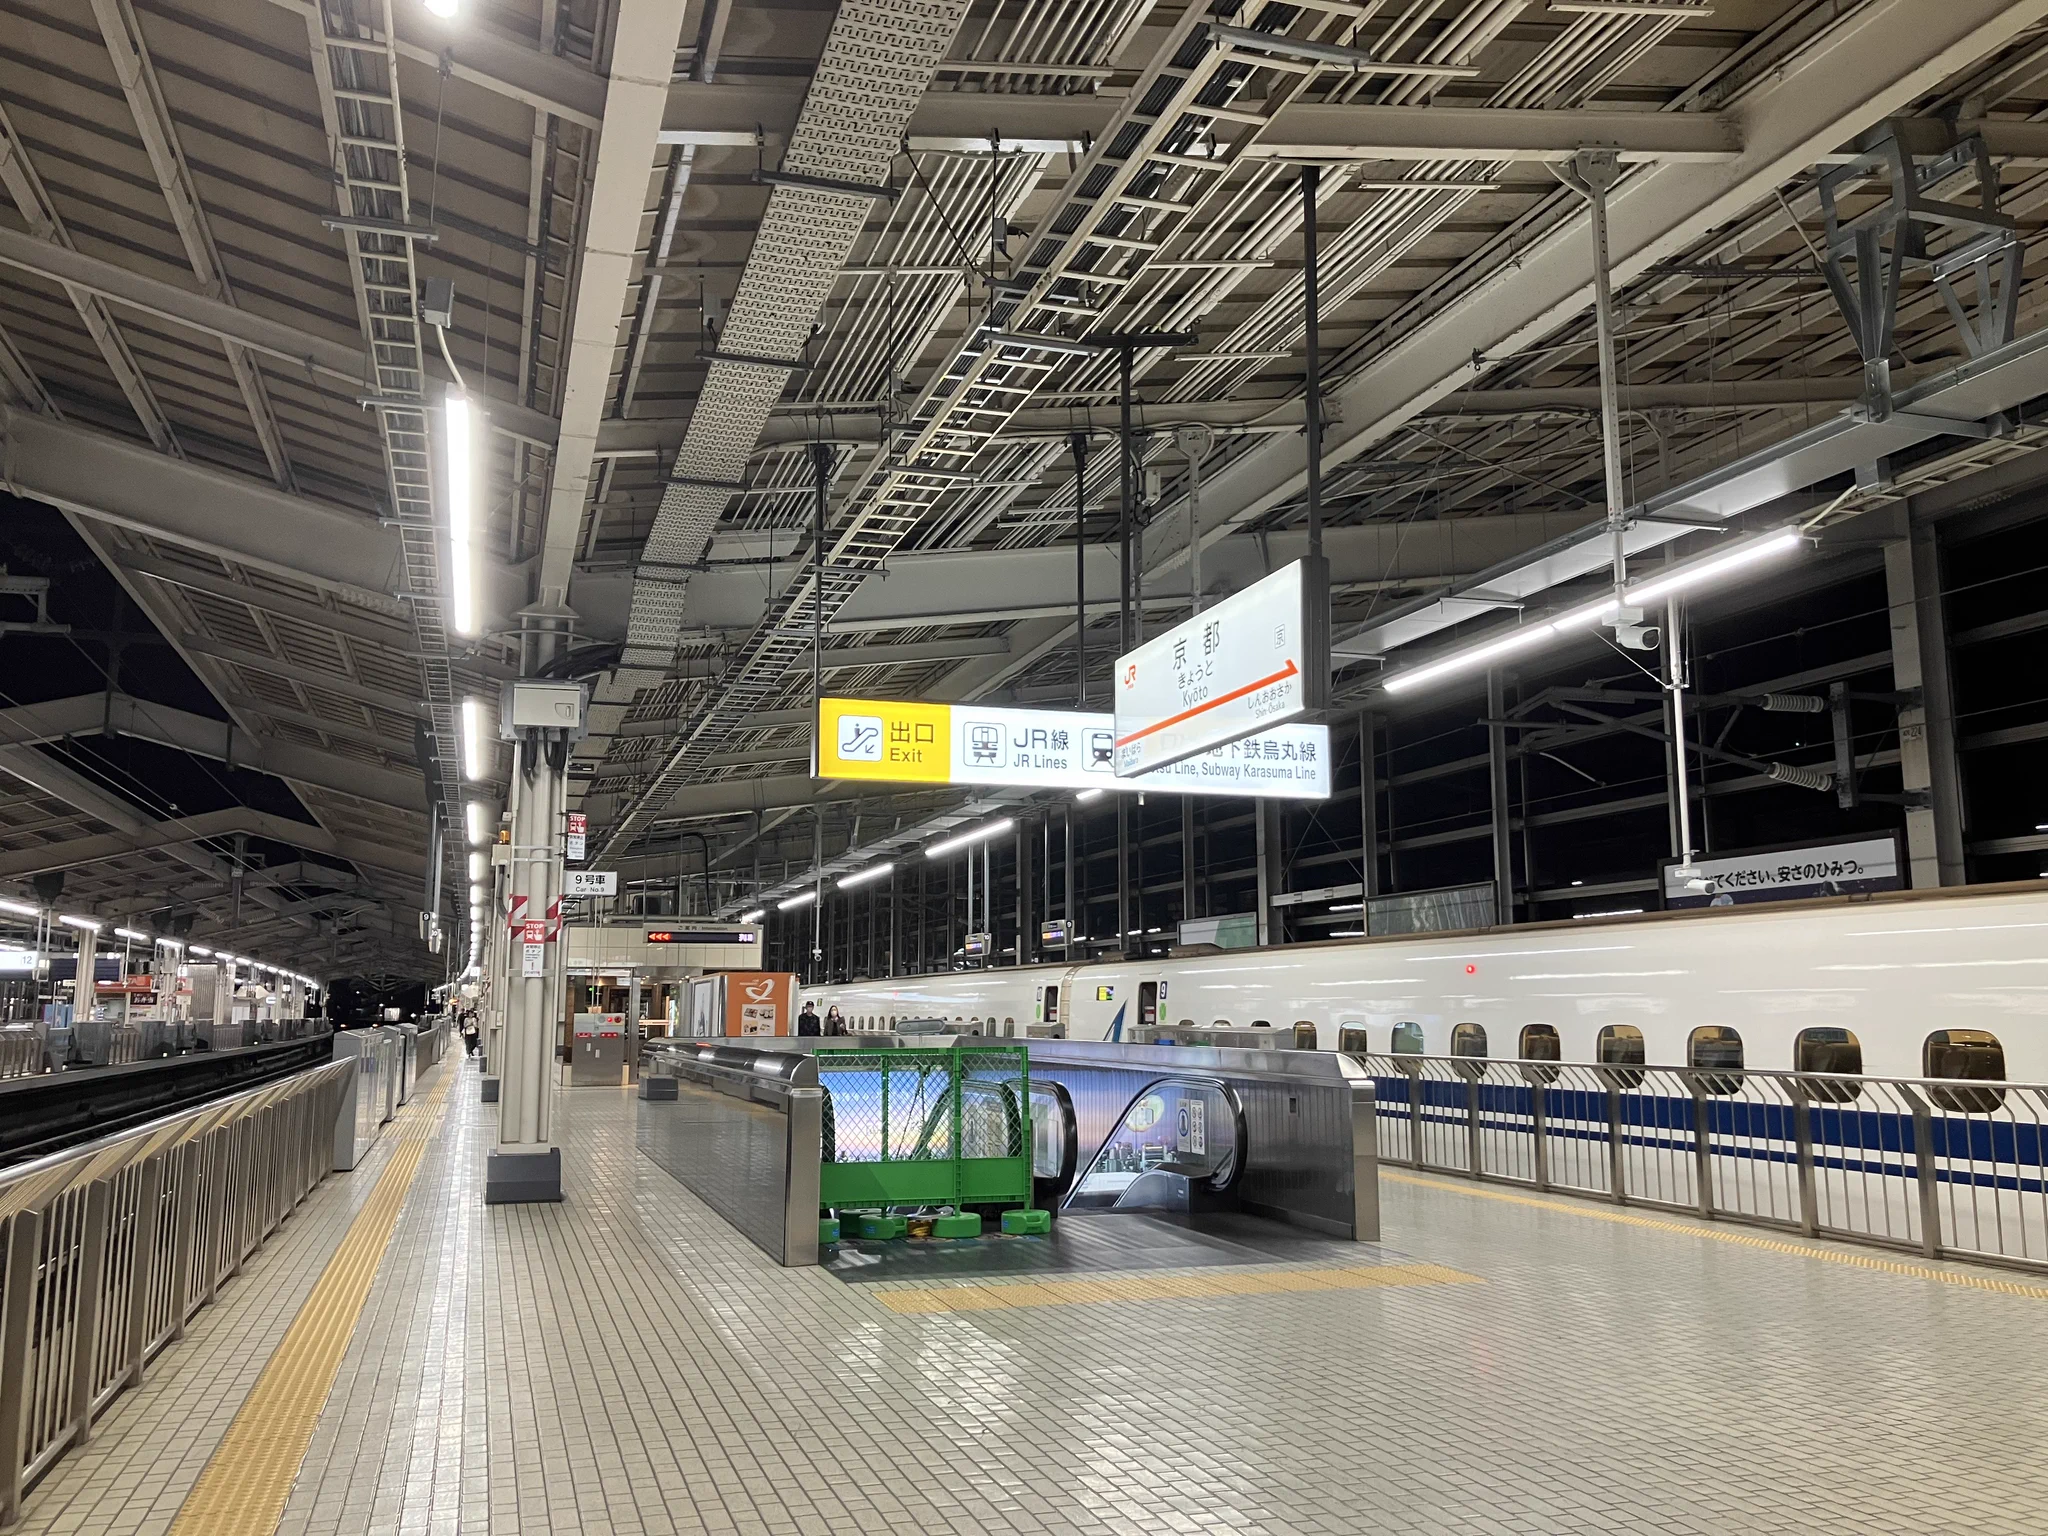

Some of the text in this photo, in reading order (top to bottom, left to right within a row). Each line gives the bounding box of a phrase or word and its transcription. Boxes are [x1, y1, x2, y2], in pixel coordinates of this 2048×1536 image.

[1173, 620, 1220, 671] 京都
[1124, 665, 1136, 685] JR
[1178, 660, 1213, 689] きょうと
[1183, 686, 1208, 708] Kyōto
[1248, 682, 1292, 709] しんおおさか
[890, 721, 934, 744] 出口
[1013, 728, 1069, 751] JR線
[890, 748, 922, 763] Exit
[1013, 754, 1068, 769] JR Lines
[1201, 762, 1241, 780] Subway
[1243, 764, 1293, 779] Karasuma
[1295, 766, 1316, 780] Line
[22, 956, 33, 965] 12
[1160, 983, 1166, 997] 9
